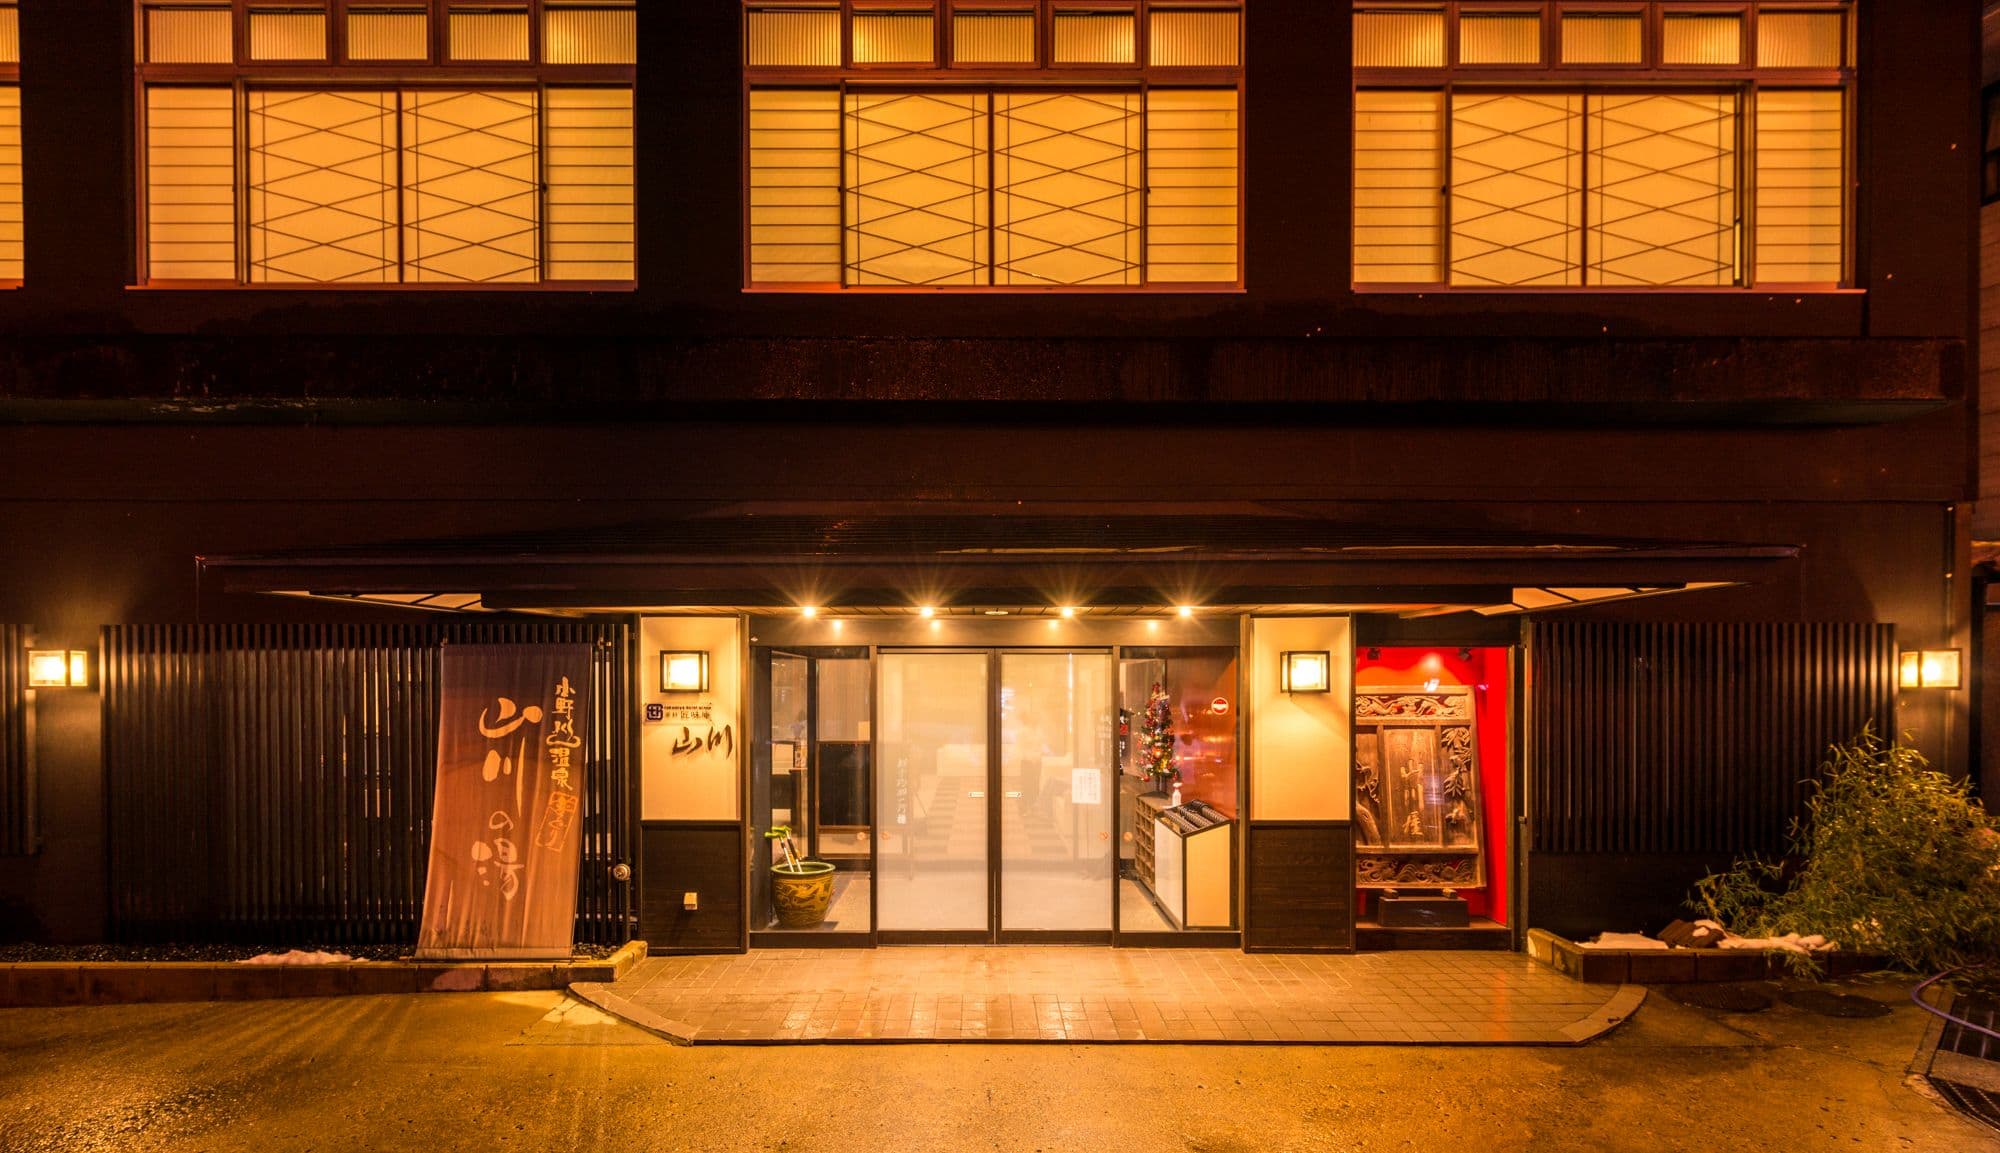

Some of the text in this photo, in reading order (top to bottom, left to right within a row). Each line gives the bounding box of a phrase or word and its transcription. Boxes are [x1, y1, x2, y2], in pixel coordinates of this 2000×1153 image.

[546, 675, 581, 791] 小野川温泉
[672, 724, 733, 759] 山川
[471, 697, 544, 902] 山川の湯
